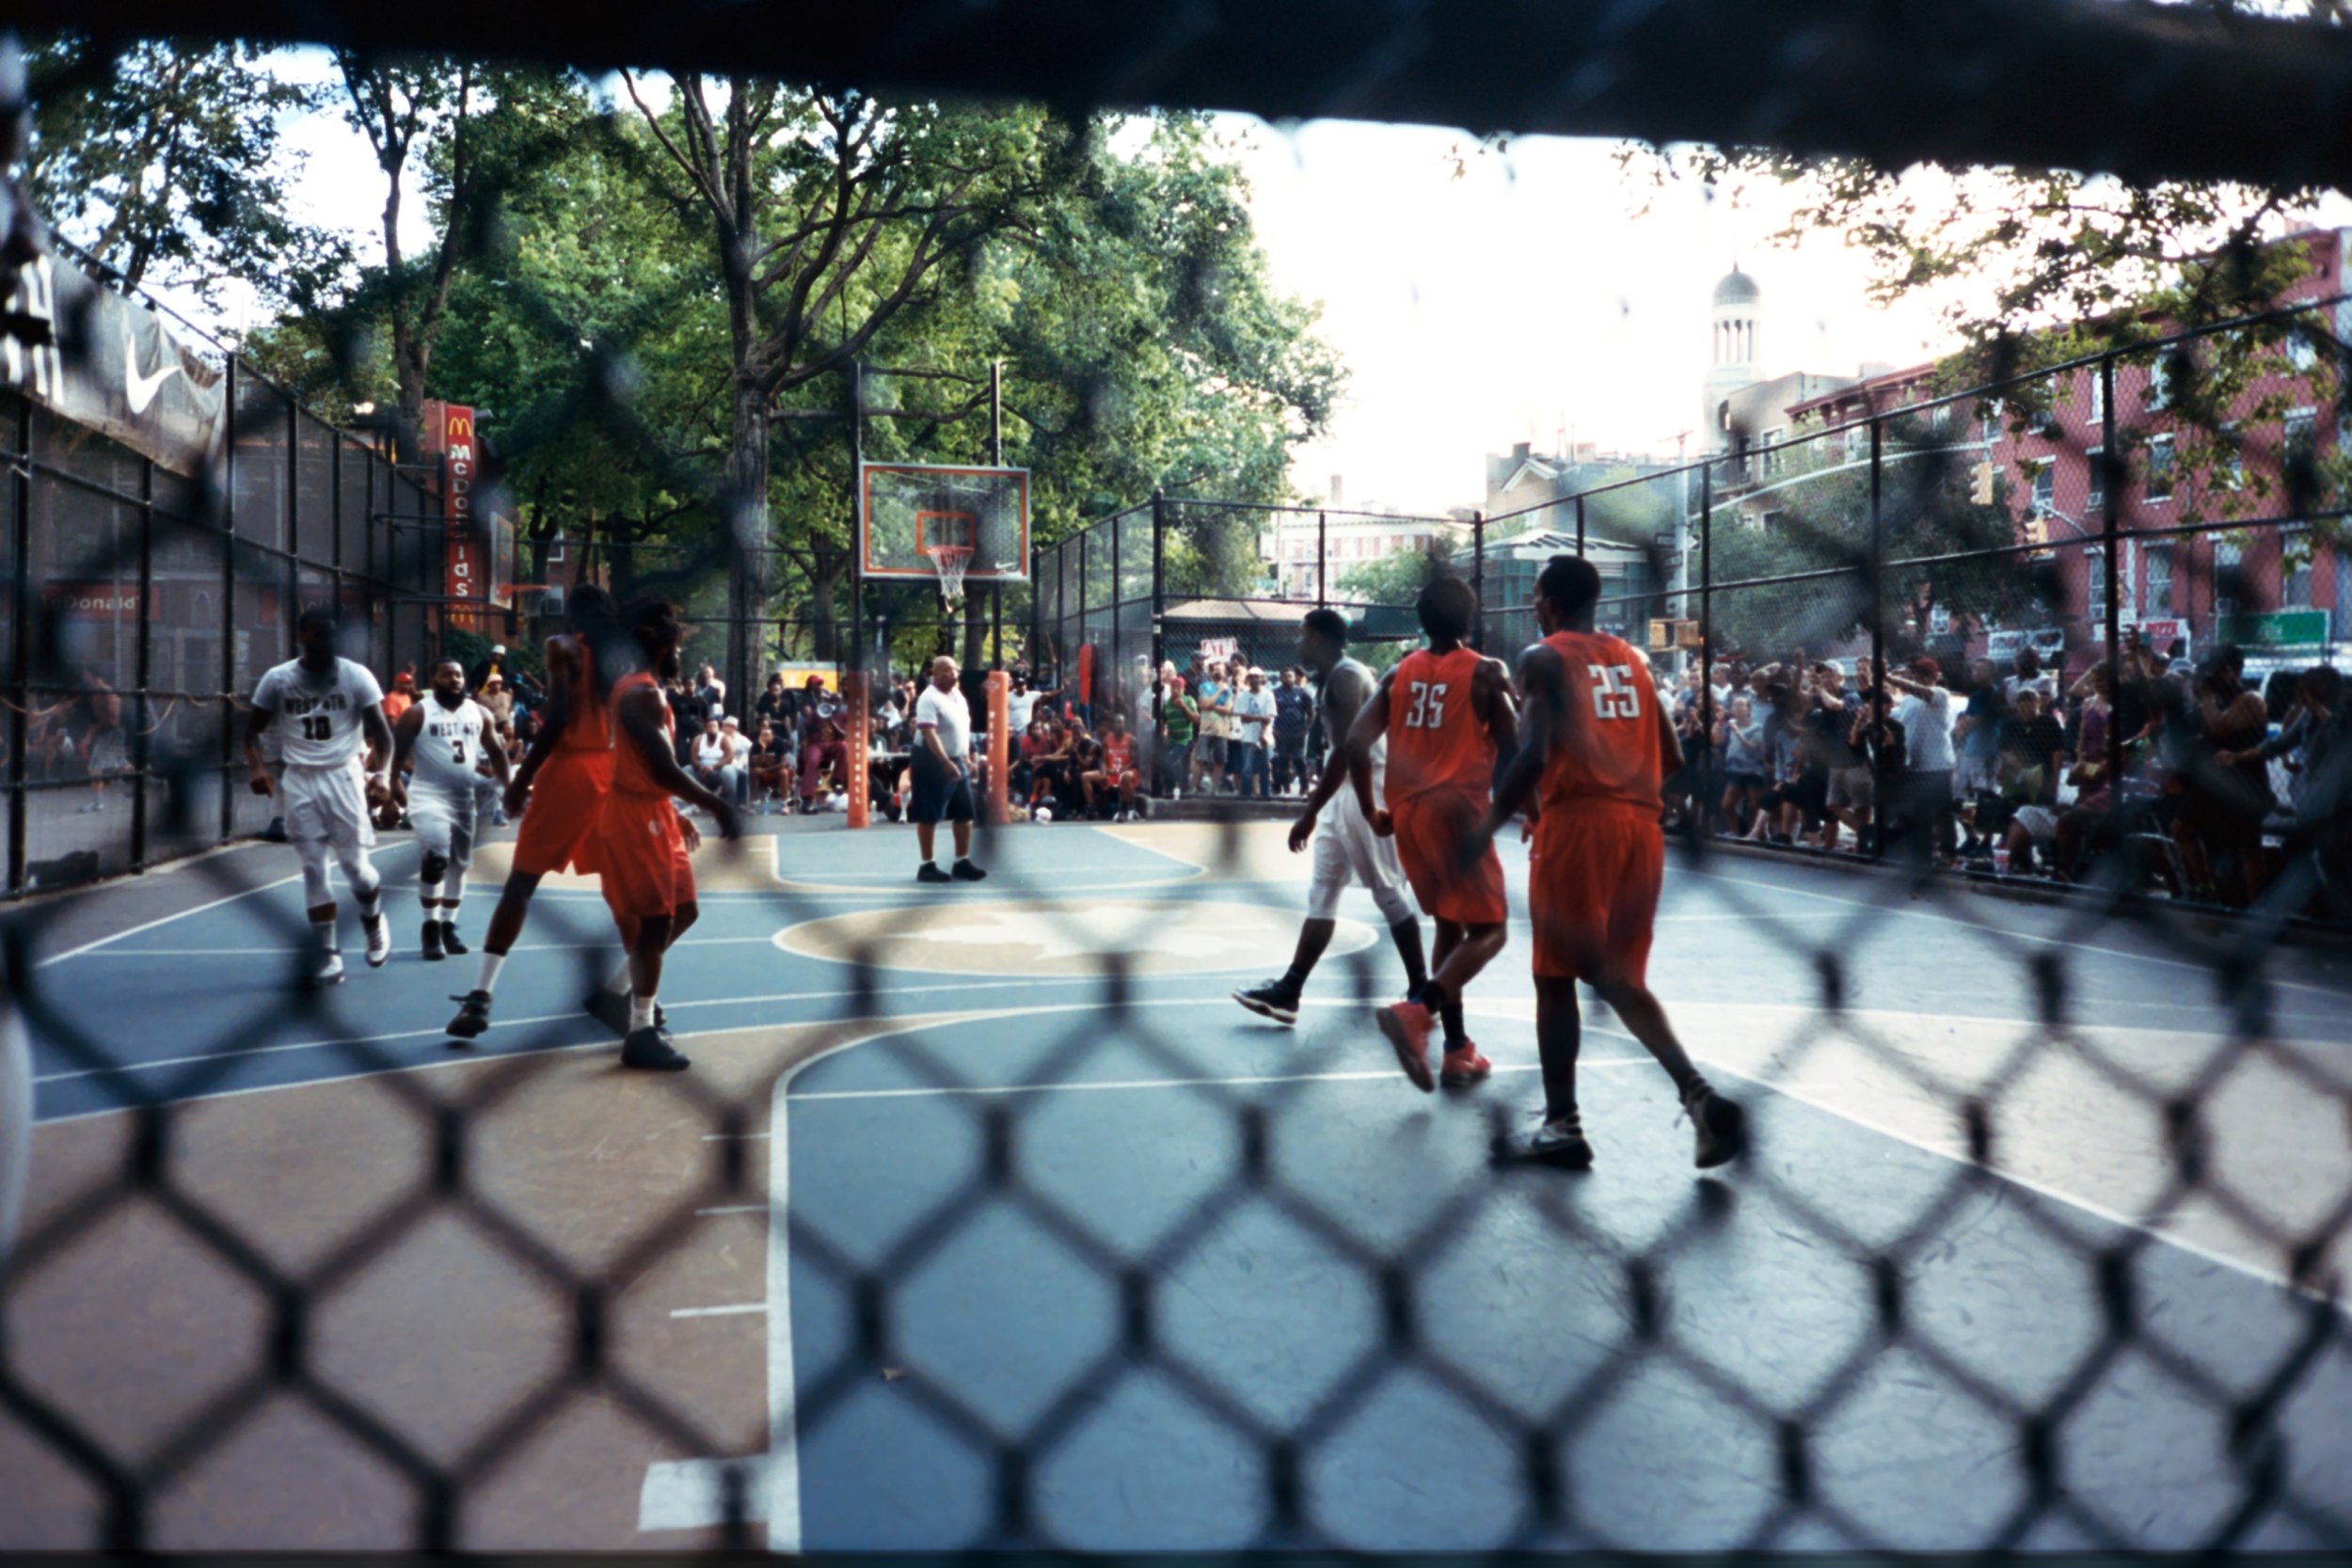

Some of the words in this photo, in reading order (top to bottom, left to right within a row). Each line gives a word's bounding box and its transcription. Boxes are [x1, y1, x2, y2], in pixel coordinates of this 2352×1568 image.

[1588, 663, 1642, 720] 25
[301, 715, 332, 741] 10
[429, 722, 459, 737] WEST
[453, 739, 467, 765] 3
